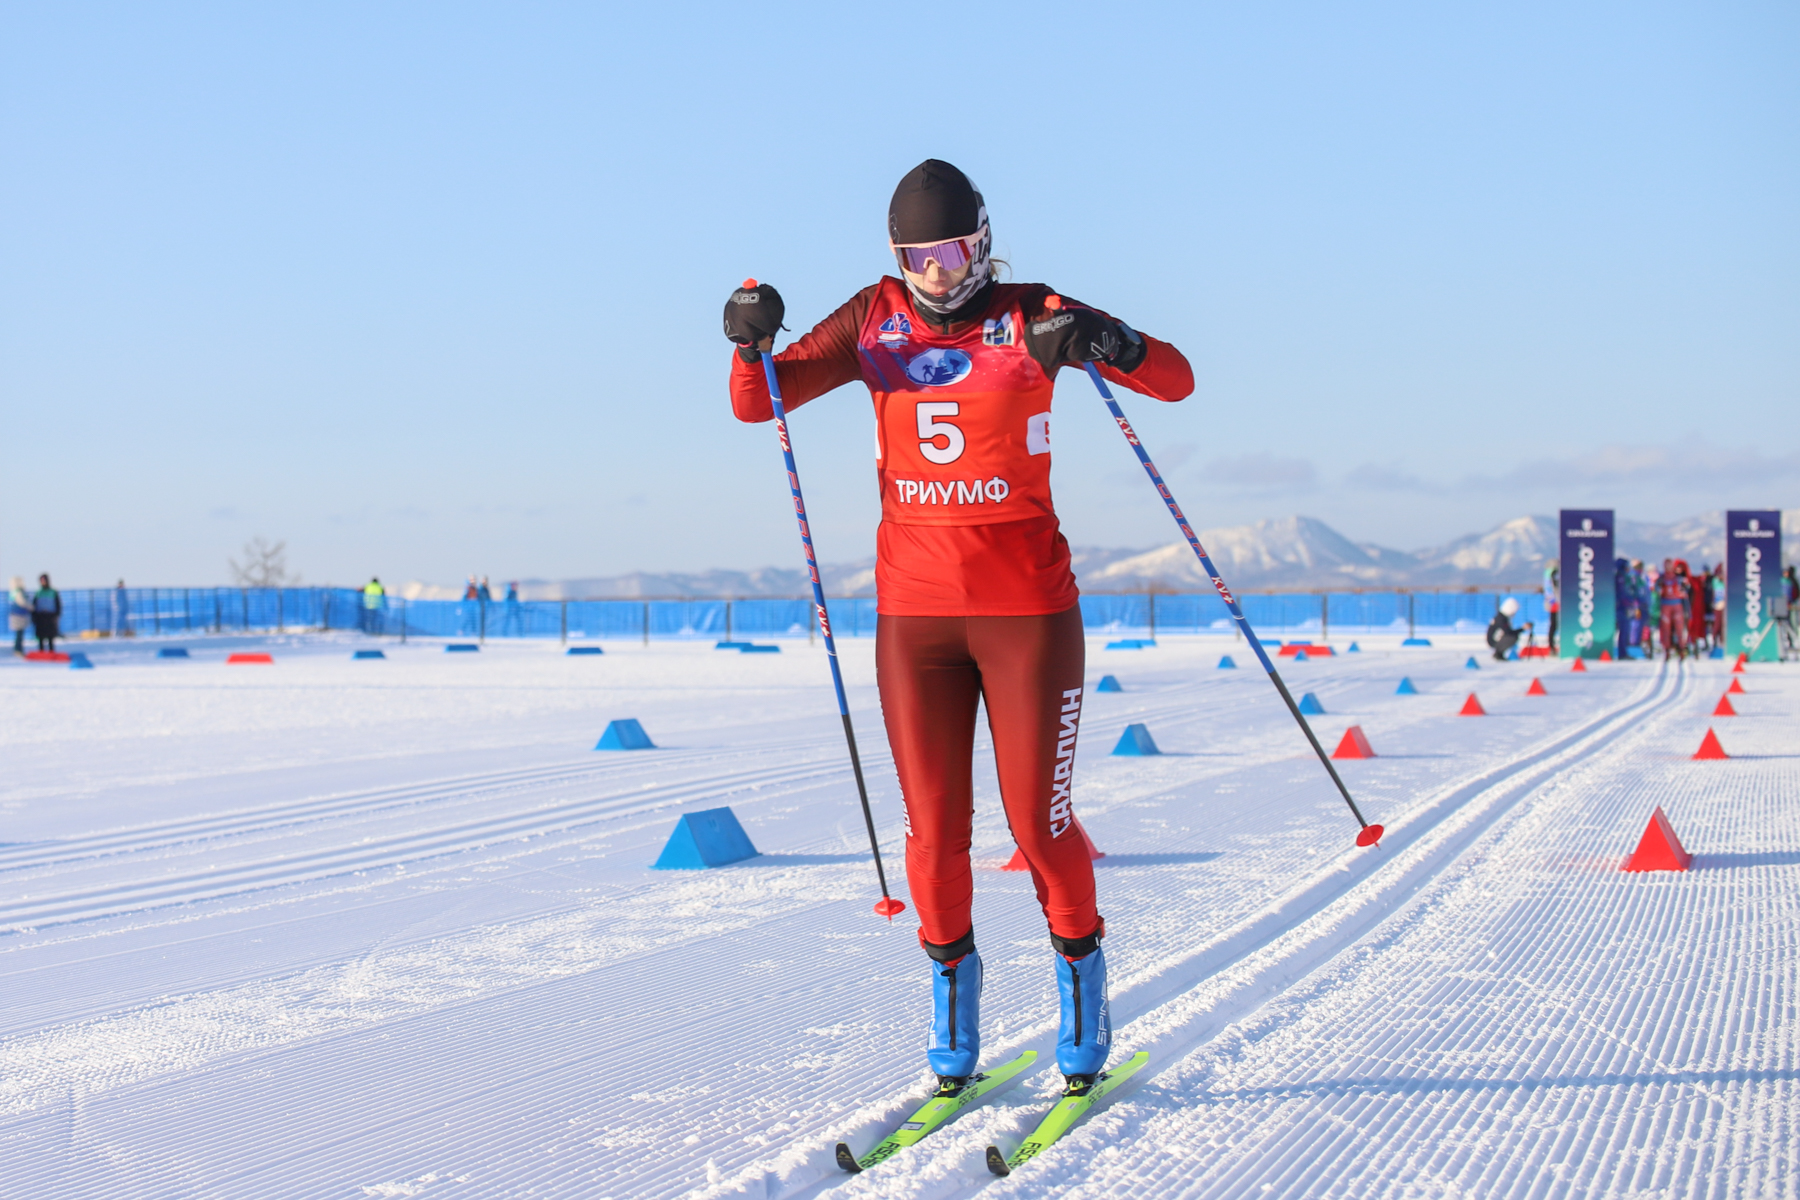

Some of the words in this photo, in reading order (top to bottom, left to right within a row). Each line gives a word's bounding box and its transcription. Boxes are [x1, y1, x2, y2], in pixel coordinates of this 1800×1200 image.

[916, 401, 965, 465] 5
[895, 476, 1010, 505] ТРИУМФ
[1578, 546, 1595, 629] ФОСАГРО
[1745, 547, 1762, 629] ФОСАГРО
[1050, 688, 1081, 838] САХАЛИН
